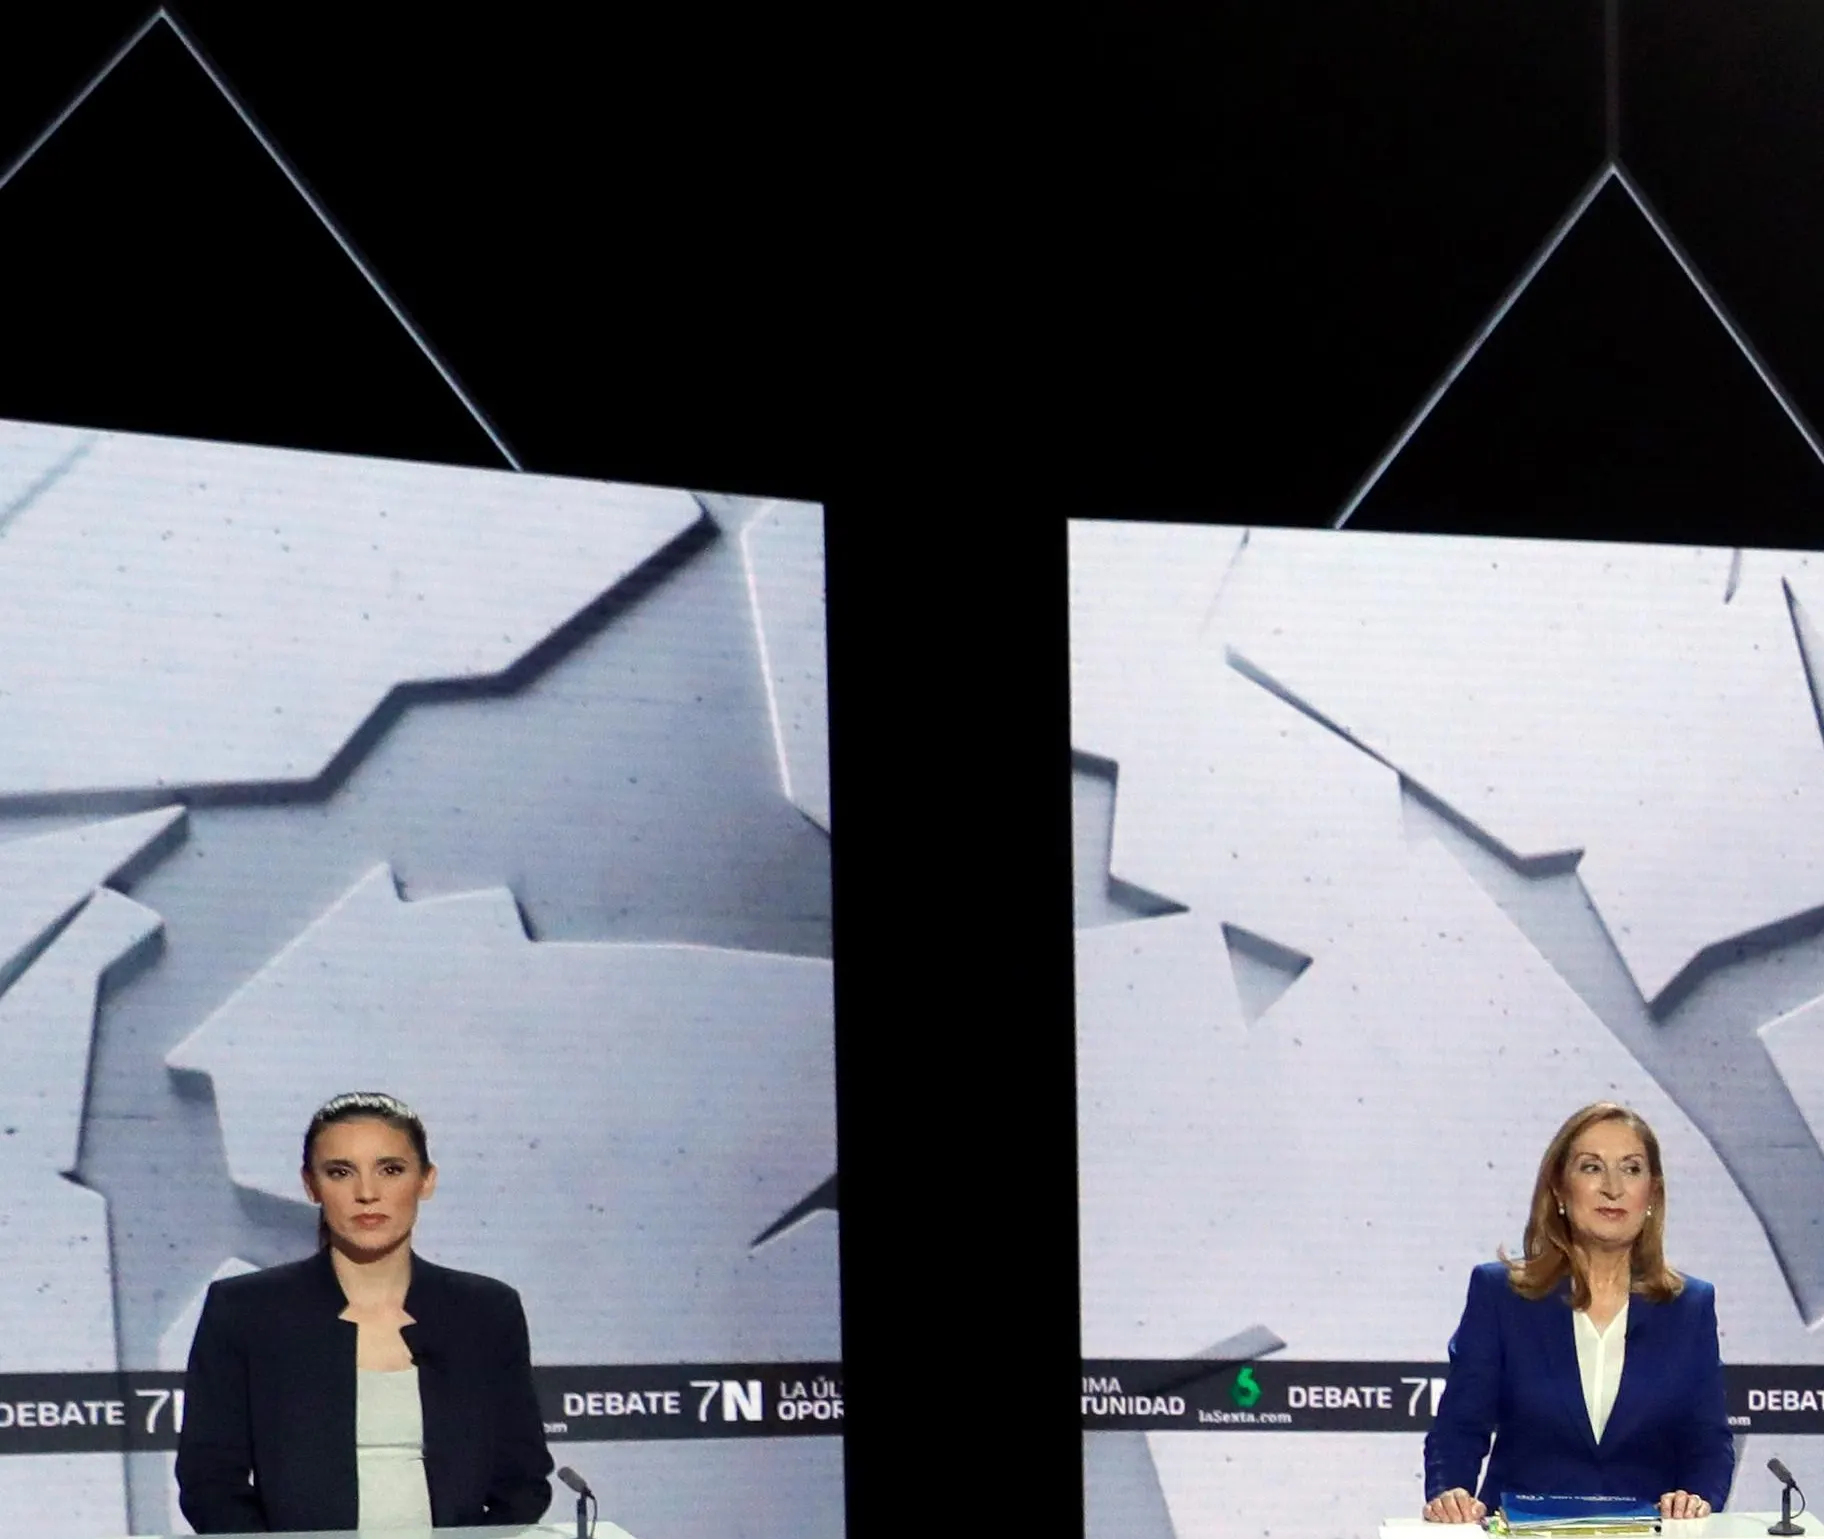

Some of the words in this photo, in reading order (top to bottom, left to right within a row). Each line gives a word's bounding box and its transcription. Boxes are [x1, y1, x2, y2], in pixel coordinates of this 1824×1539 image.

[780, 1381, 807, 1398] LA
[1082, 1377, 1123, 1393] IMA
[563, 1392, 681, 1416] DEBATE
[689, 1380, 763, 1422] 7N
[1081, 1396, 1185, 1415] TUNIDAD
[1287, 1386, 1393, 1409] DEBATE
[0, 1401, 125, 1427] DEBATE
[1198, 1409, 1292, 1423] laSexta.com
